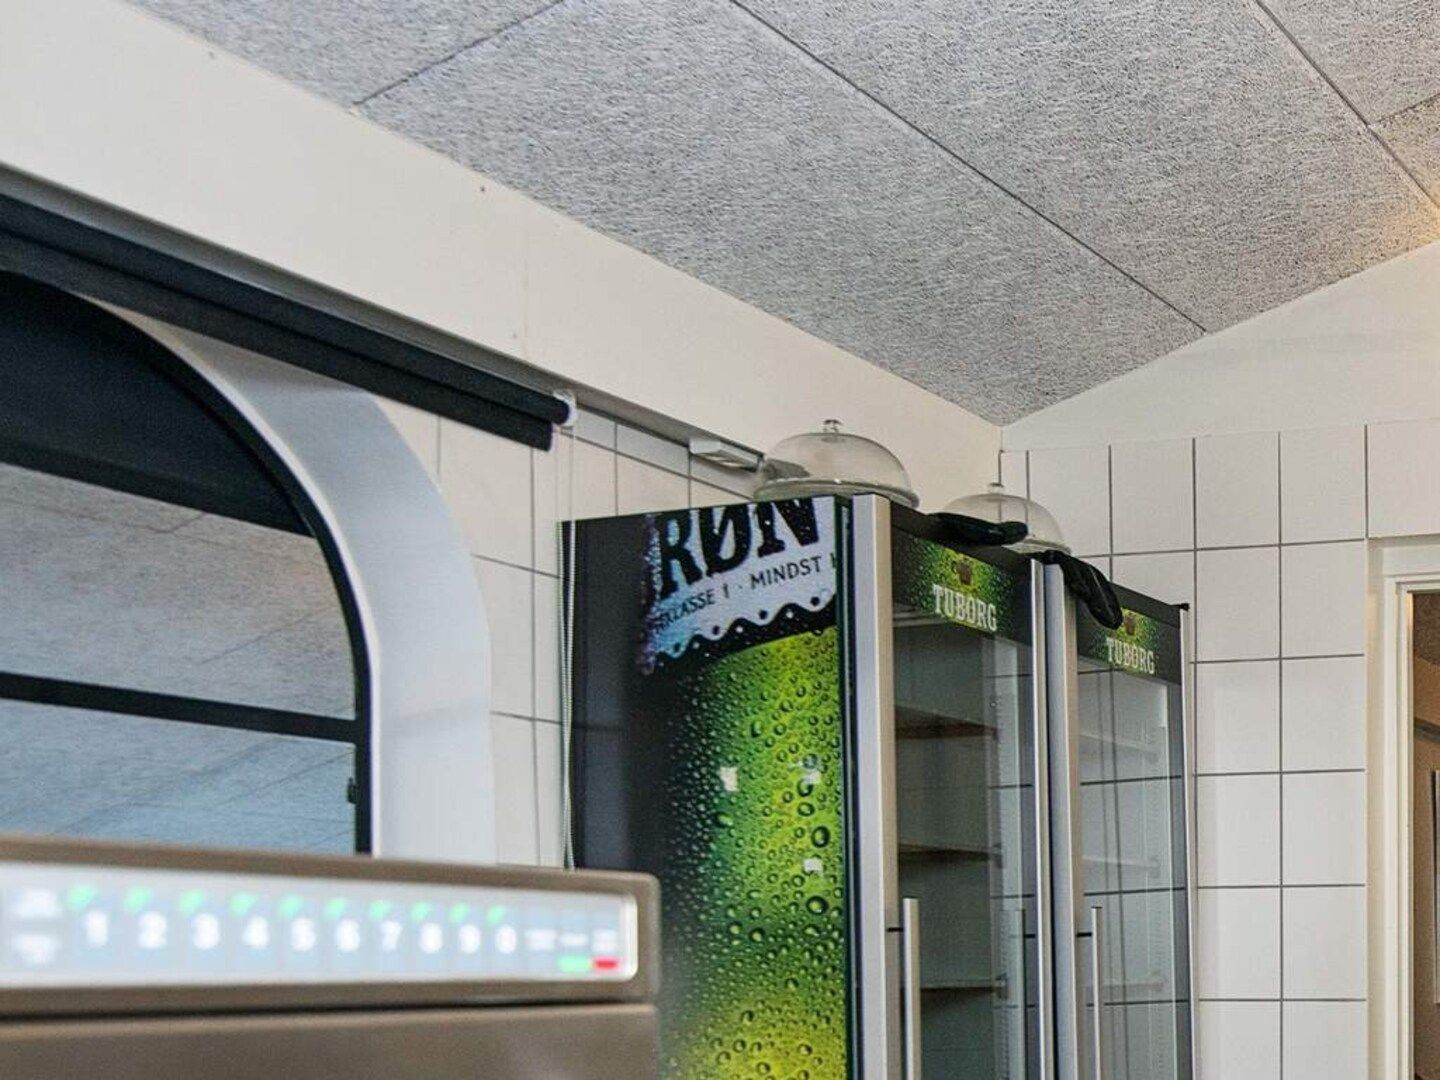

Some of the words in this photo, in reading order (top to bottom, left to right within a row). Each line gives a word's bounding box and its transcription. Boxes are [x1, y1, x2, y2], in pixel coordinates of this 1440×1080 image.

[749, 554, 822, 590] MINDST
[932, 583, 998, 632] TUBORG
[1106, 636, 1156, 674] TUBORG
[84, 908, 109, 948] 1
[138, 911, 167, 949] 2
[192, 912, 220, 950] 3
[242, 915, 269, 949] 4
[290, 916, 316, 952] 5
[336, 919, 360, 951] 6
[380, 920, 402, 951] 7
[420, 922, 443, 954] 8
[458, 924, 481, 954] 9
[495, 925, 517, 954] 0
